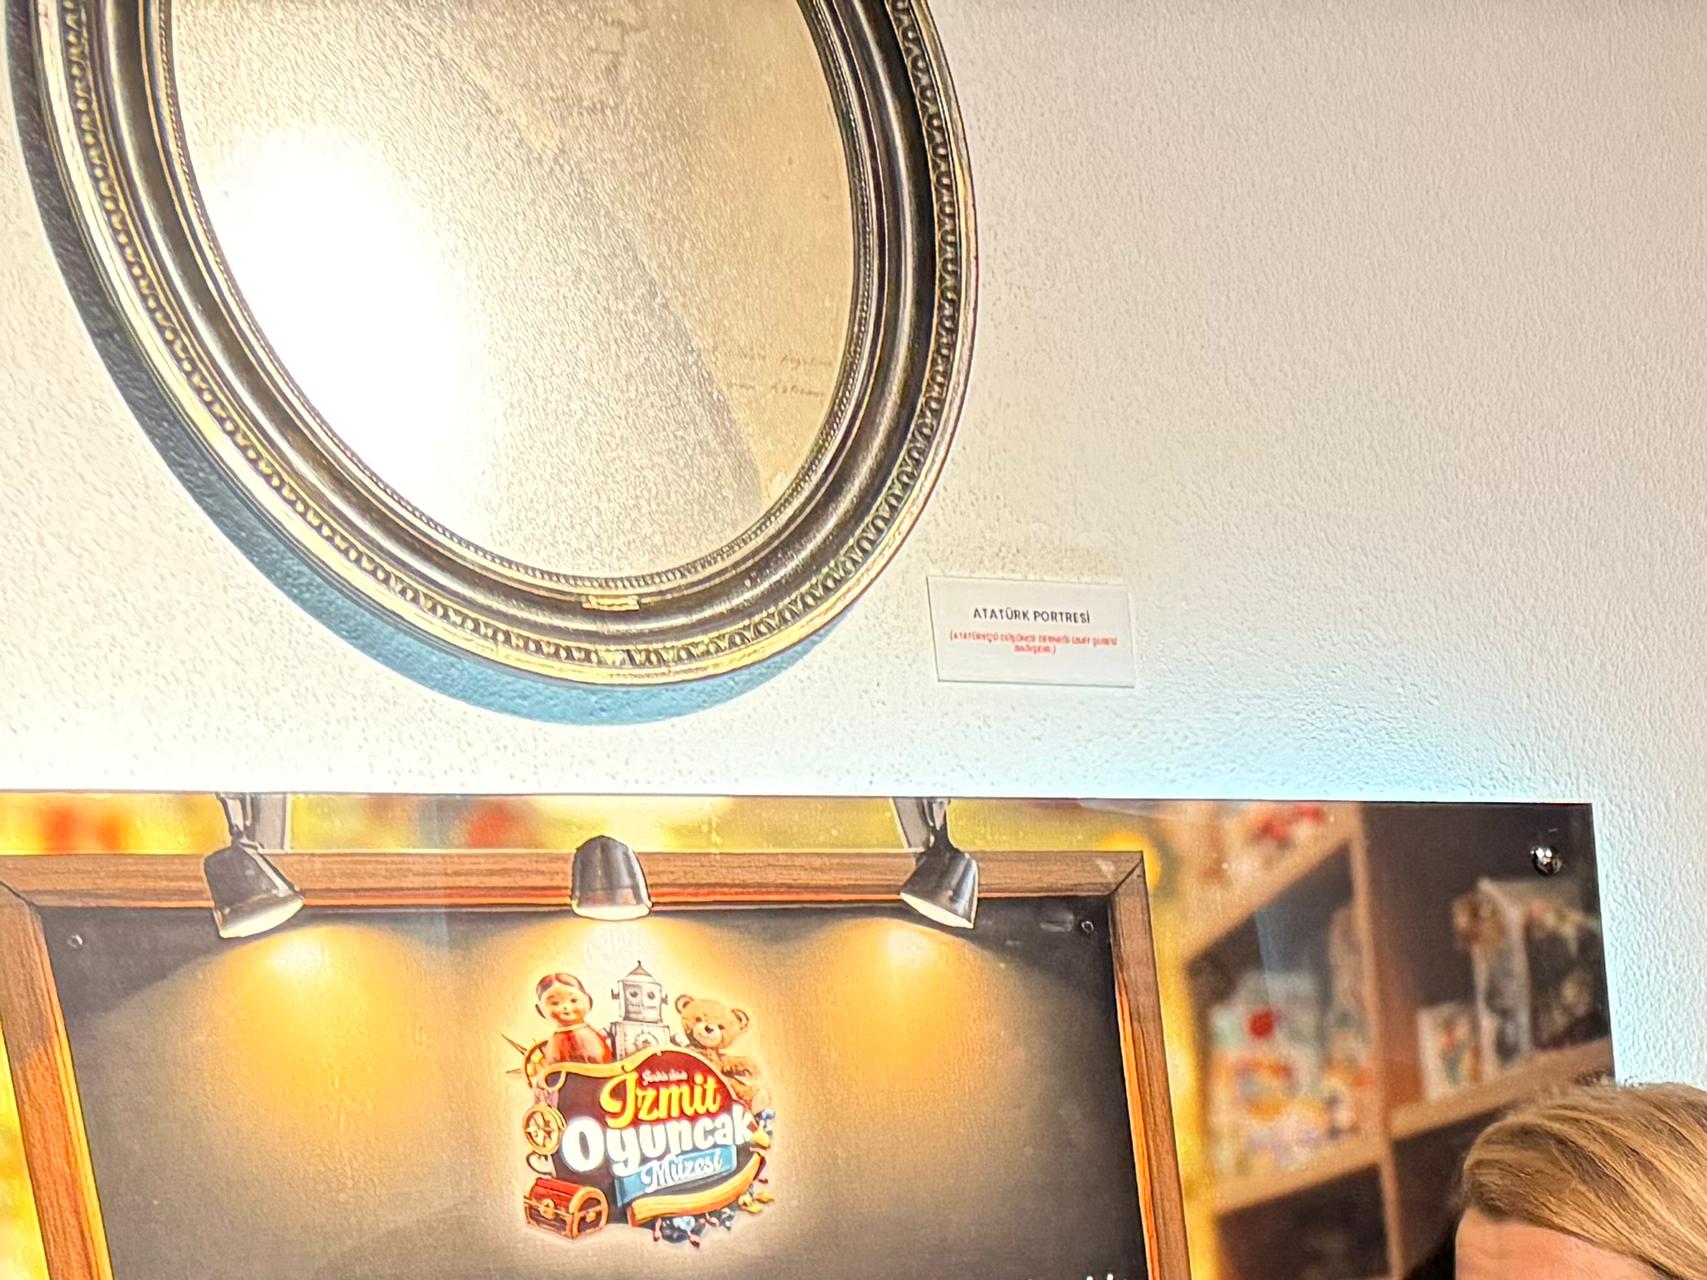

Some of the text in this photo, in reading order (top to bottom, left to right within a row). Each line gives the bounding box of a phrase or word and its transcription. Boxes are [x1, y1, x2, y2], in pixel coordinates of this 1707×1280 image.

[973, 607, 1091, 624] ATATÜRK PORTRESİ
[562, 1102, 753, 1176] Oyuncak
